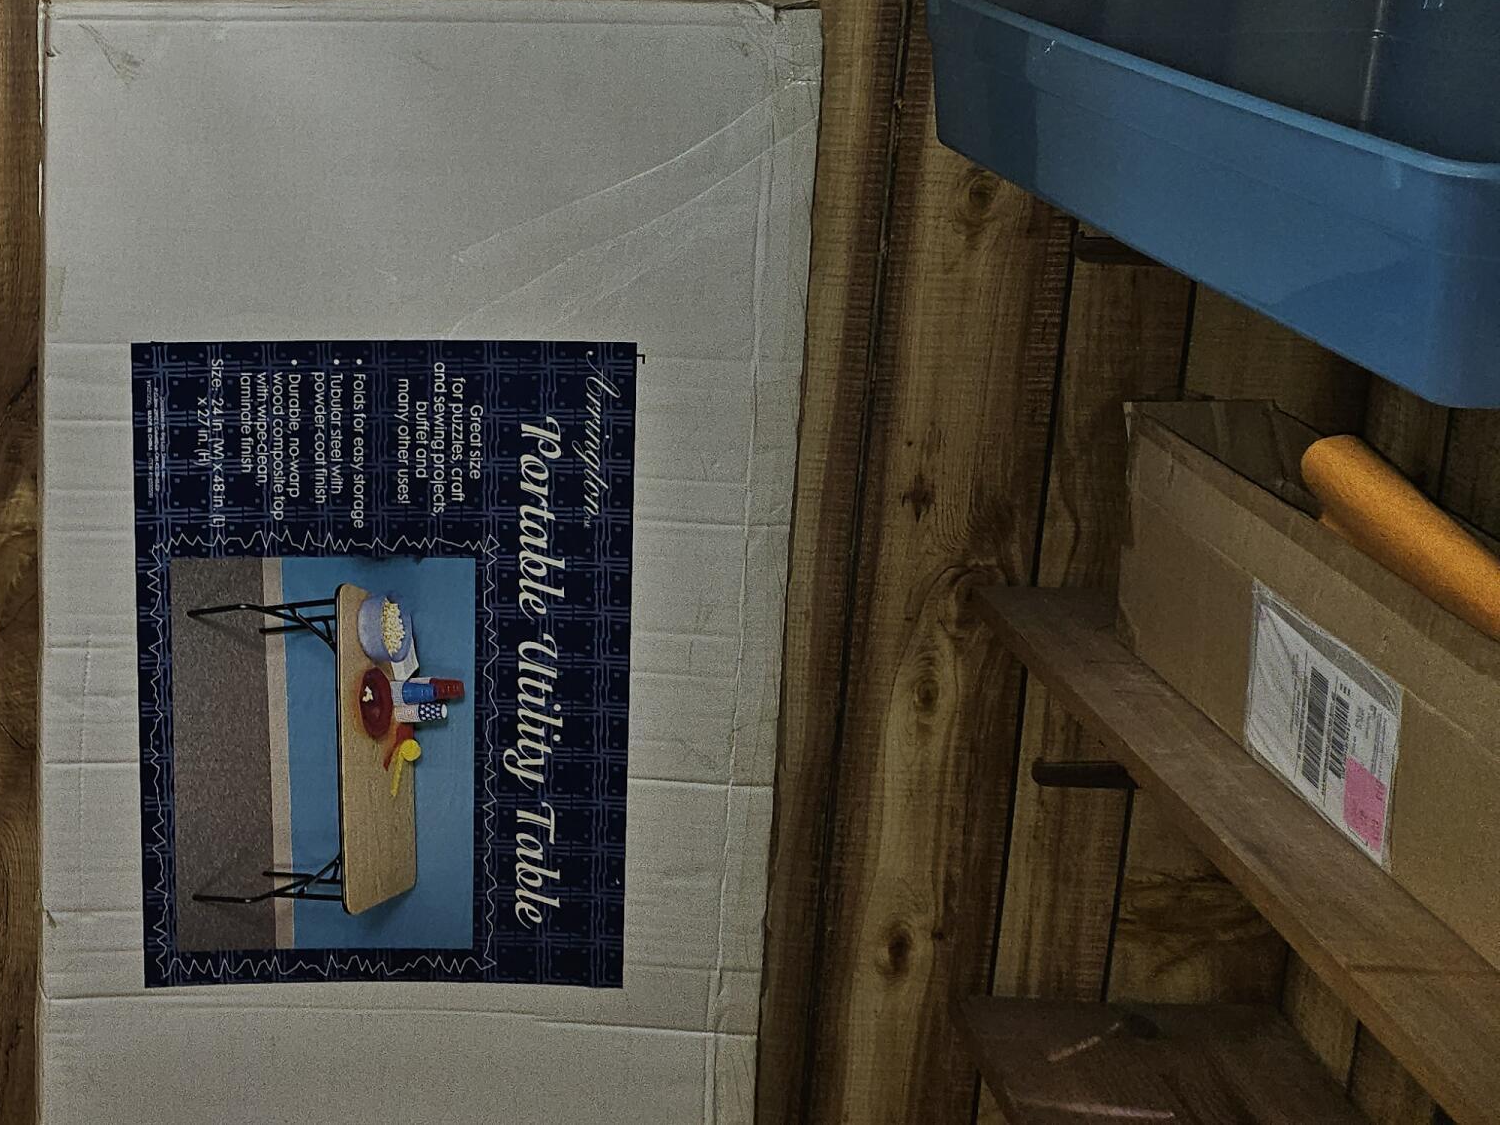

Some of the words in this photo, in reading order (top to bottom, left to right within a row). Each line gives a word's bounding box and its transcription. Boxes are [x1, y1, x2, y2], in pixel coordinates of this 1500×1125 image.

[211, 358, 224, 391] Size:
[256, 372, 269, 401] with
[353, 373, 366, 410] Folds
[433, 362, 447, 393] and
[451, 377, 467, 399] for
[197, 396, 208, 406] x
[211, 398, 223, 415] 24
[240, 372, 253, 435] laminate
[272, 372, 285, 415] wood
[287, 374, 301, 434] Durable,
[330, 373, 343, 427] Tubular
[394, 378, 409, 422] many
[197, 409, 210, 425] 27
[212, 418, 225, 434] in.
[311, 372, 327, 465] powder-coat
[353, 413, 367, 434] for
[415, 401, 429, 445] buffet
[430, 396, 447, 450] sewing
[448, 403, 466, 464] puzzles,
[469, 404, 484, 447] Great
[571, 351, 621, 516] Arrington
[197, 429, 210, 445] in.
[208, 438, 225, 460] (W)
[254, 405, 269, 487] wipe-clean,
[330, 429, 343, 462] steel
[350, 437, 364, 472] easy
[398, 425, 411, 466] other
[193, 448, 210, 467] (H)
[212, 463, 223, 472] x
[240, 437, 253, 473] finish
[270, 418, 286, 493] composite
[286, 437, 300, 498] no-warp
[415, 448, 429, 478] and
[469, 450, 484, 480] size
[212, 475, 224, 492] 48
[314, 468, 327, 504] finish
[330, 465, 344, 494] with
[398, 469, 411, 504] uses!
[430, 453, 447, 517] projects,
[451, 467, 466, 502] craft
[212, 495, 225, 511] in.
[270, 496, 285, 521] top
[350, 474, 366, 529] storage
[518, 416, 565, 621] Portable
[209, 514, 225, 528] (L)
[503, 633, 563, 791] Utility
[515, 801, 560, 929] Table
